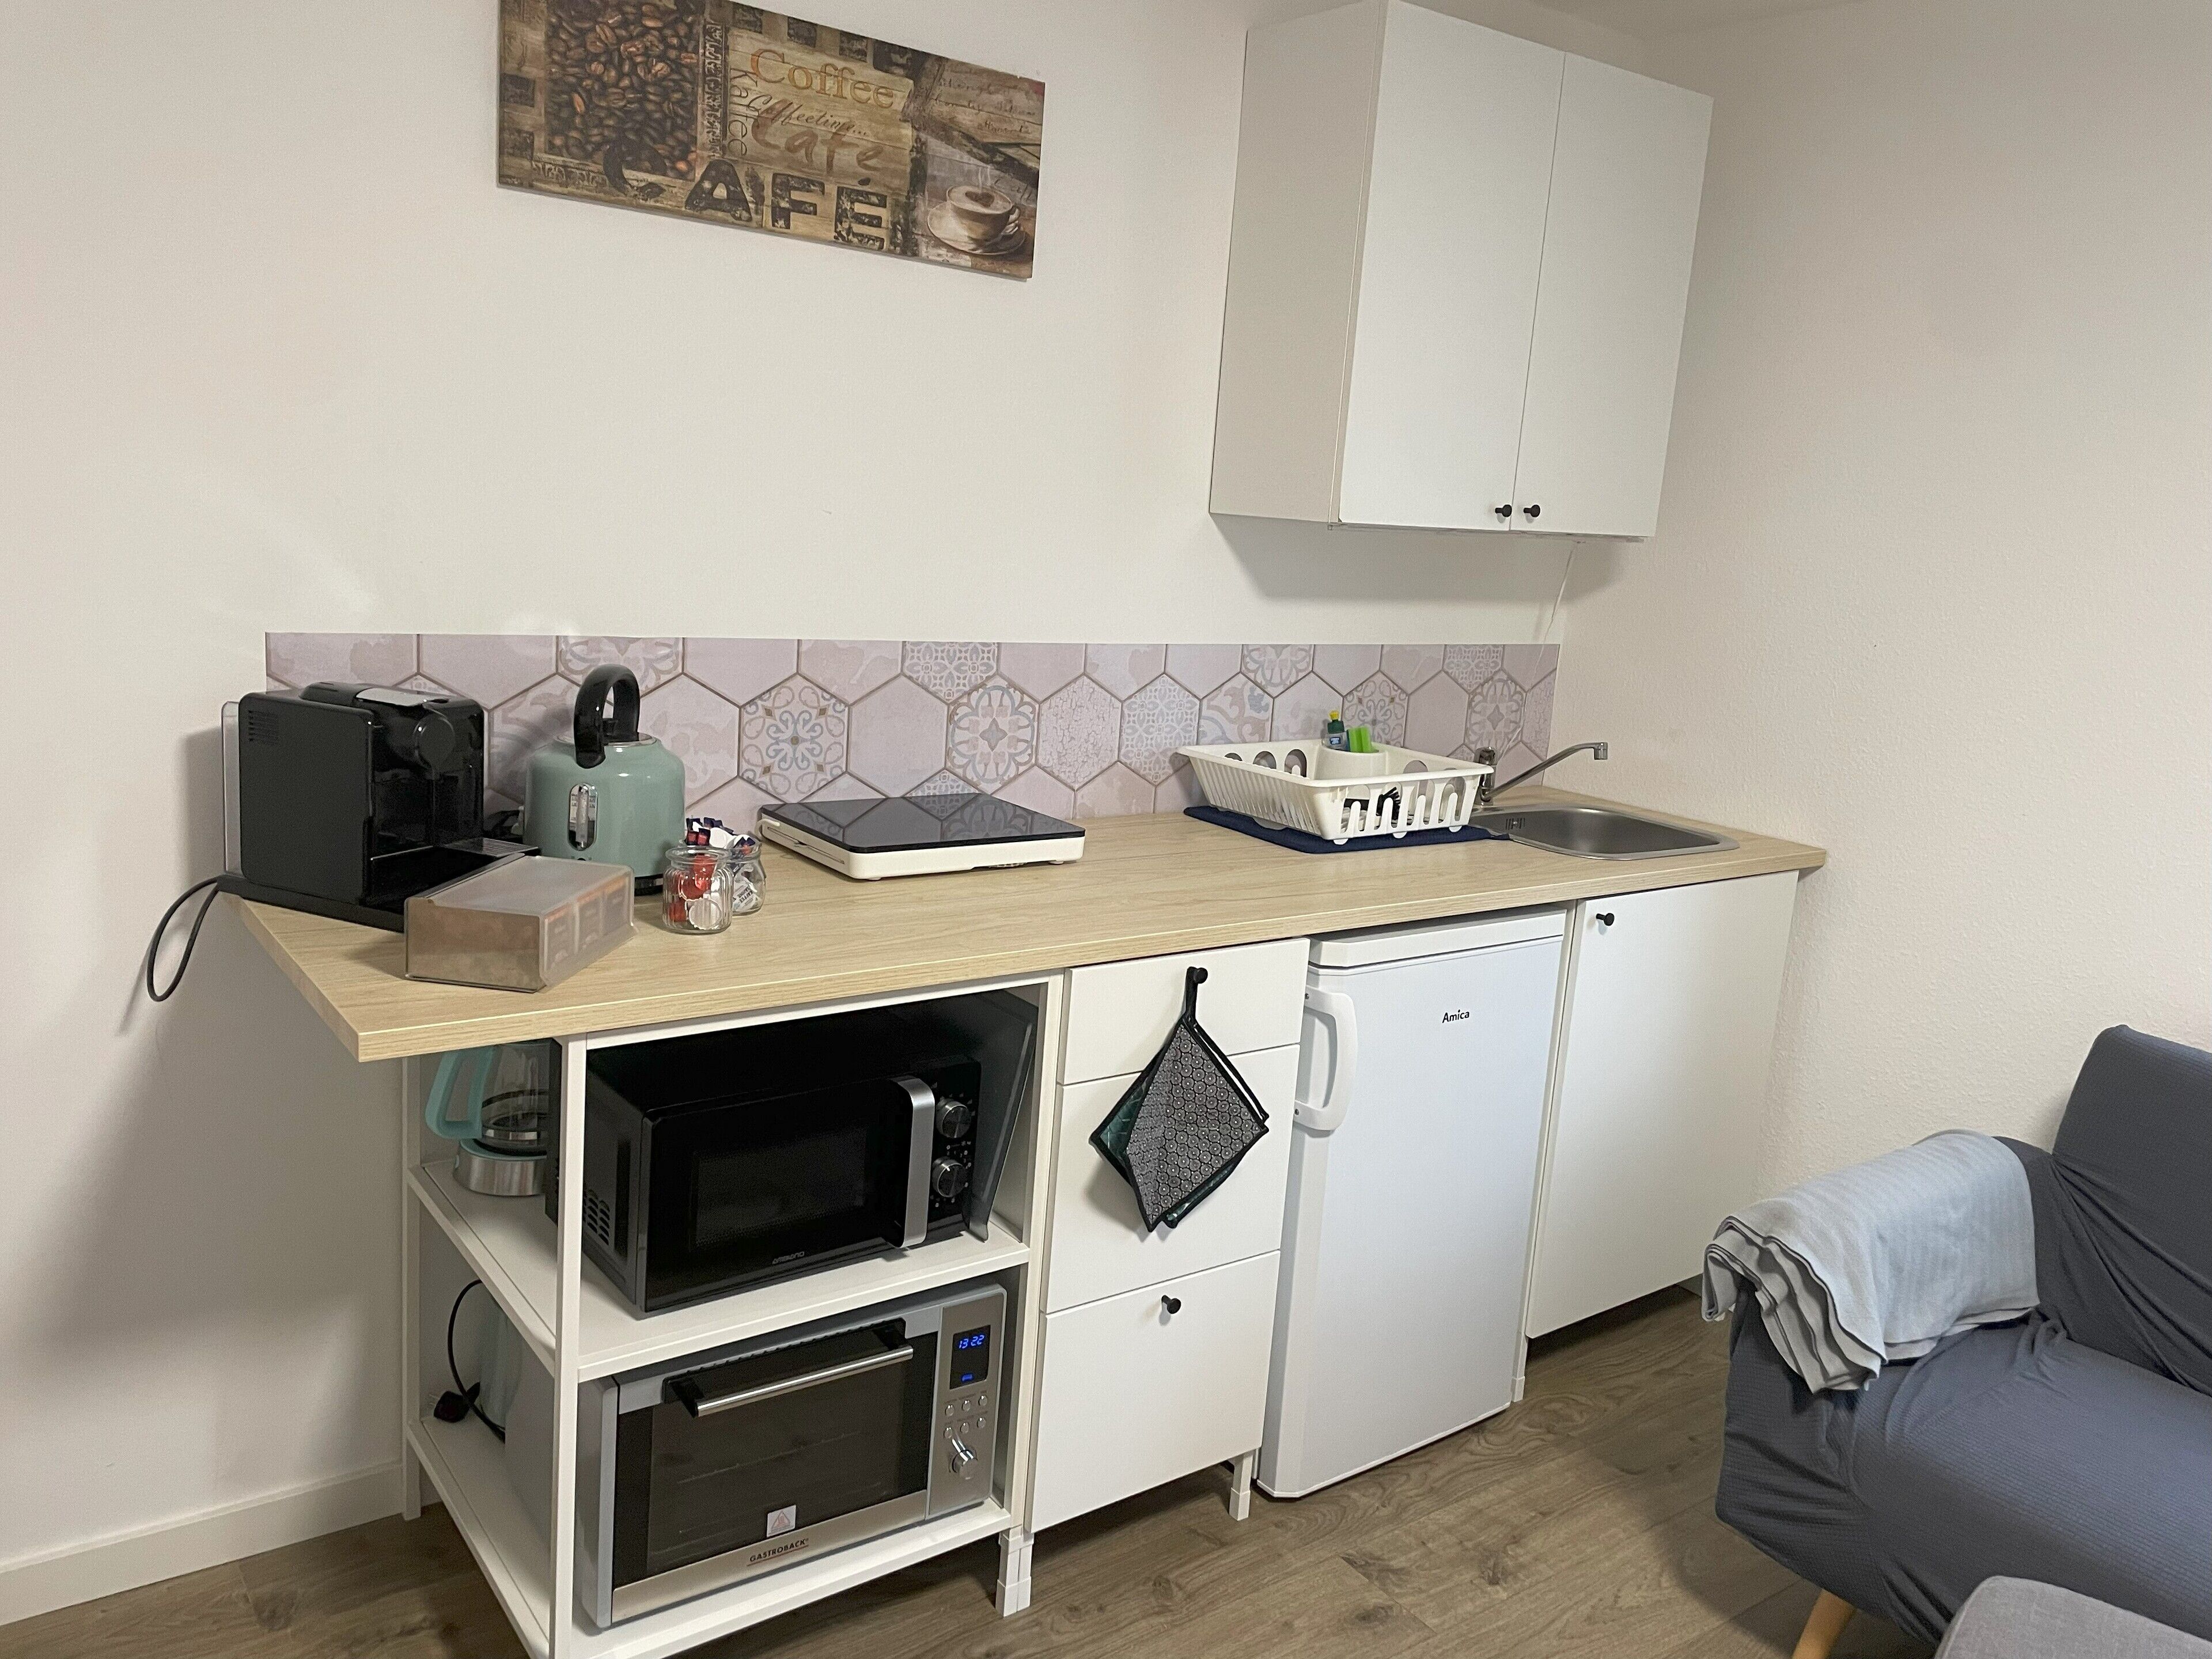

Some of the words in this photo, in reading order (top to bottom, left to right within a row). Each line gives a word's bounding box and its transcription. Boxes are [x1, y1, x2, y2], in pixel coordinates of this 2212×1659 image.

[751, 48, 895, 108] Coffee
[1442, 1009, 1469, 1023] Amica
[749, 1539, 806, 1562] GASTROBACK
